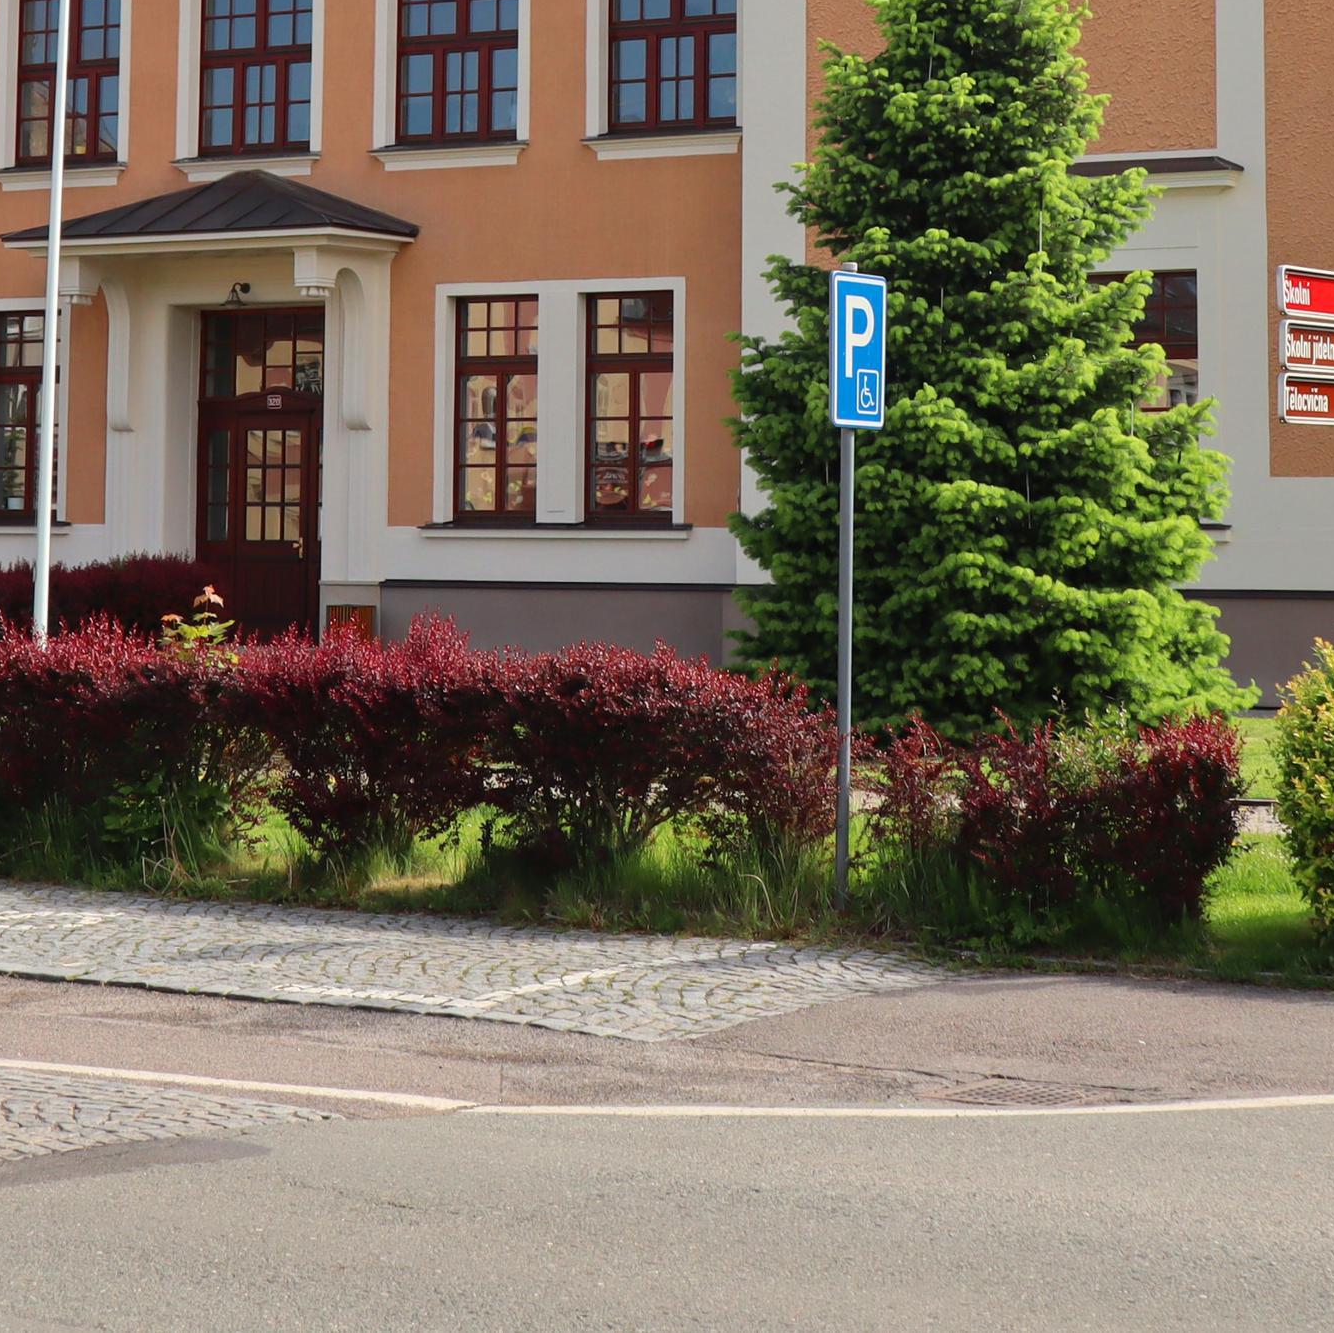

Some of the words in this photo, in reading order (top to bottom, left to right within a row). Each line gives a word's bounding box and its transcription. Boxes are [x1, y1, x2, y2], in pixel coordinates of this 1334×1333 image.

[1284, 275, 1310, 305] Školní
[845, 295, 874, 378] P
[1286, 328, 1311, 359] Školní
[1285, 386, 1329, 413] Tělocvična
